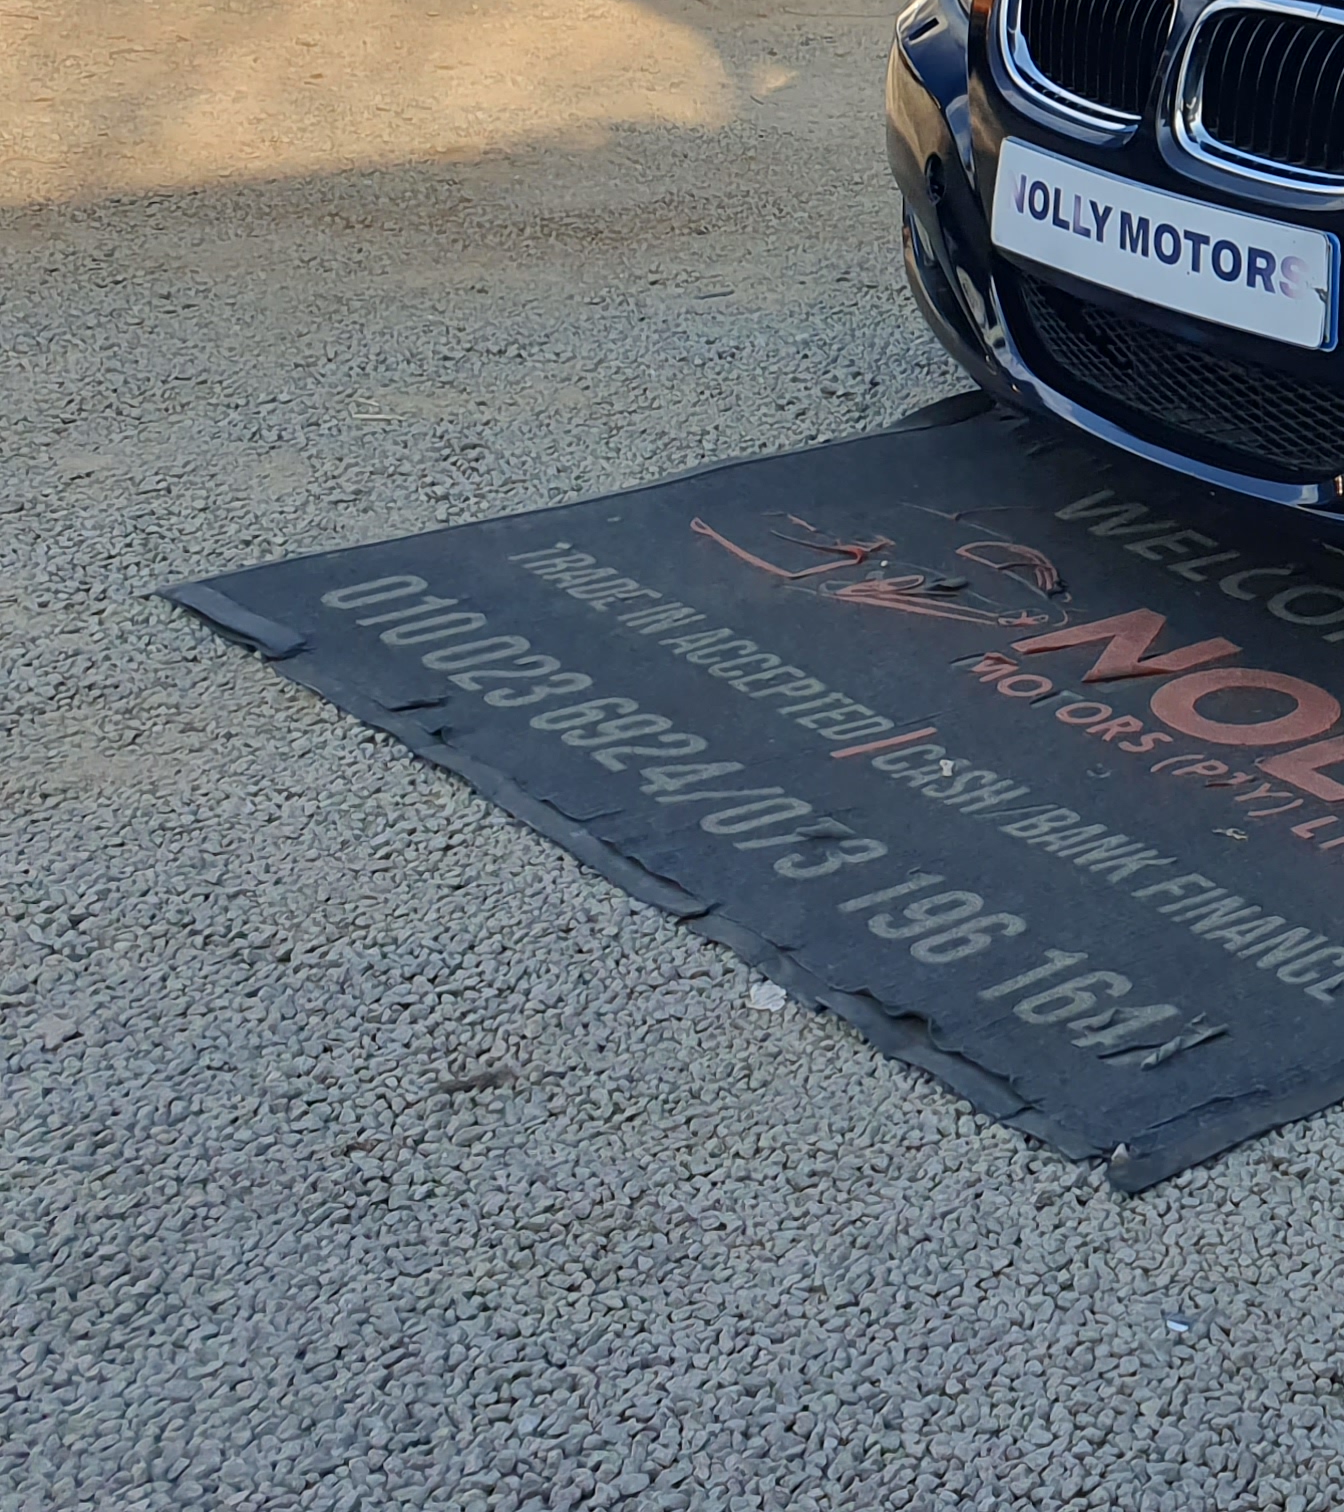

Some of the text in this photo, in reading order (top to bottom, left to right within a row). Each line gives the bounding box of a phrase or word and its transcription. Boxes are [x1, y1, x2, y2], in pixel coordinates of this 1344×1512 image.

[1119, 210, 1308, 300] MOTORS
[508, 541, 663, 612] TRADE
[617, 601, 707, 635] IN
[320, 574, 487, 646] 010
[837, 866, 1027, 964] 196
